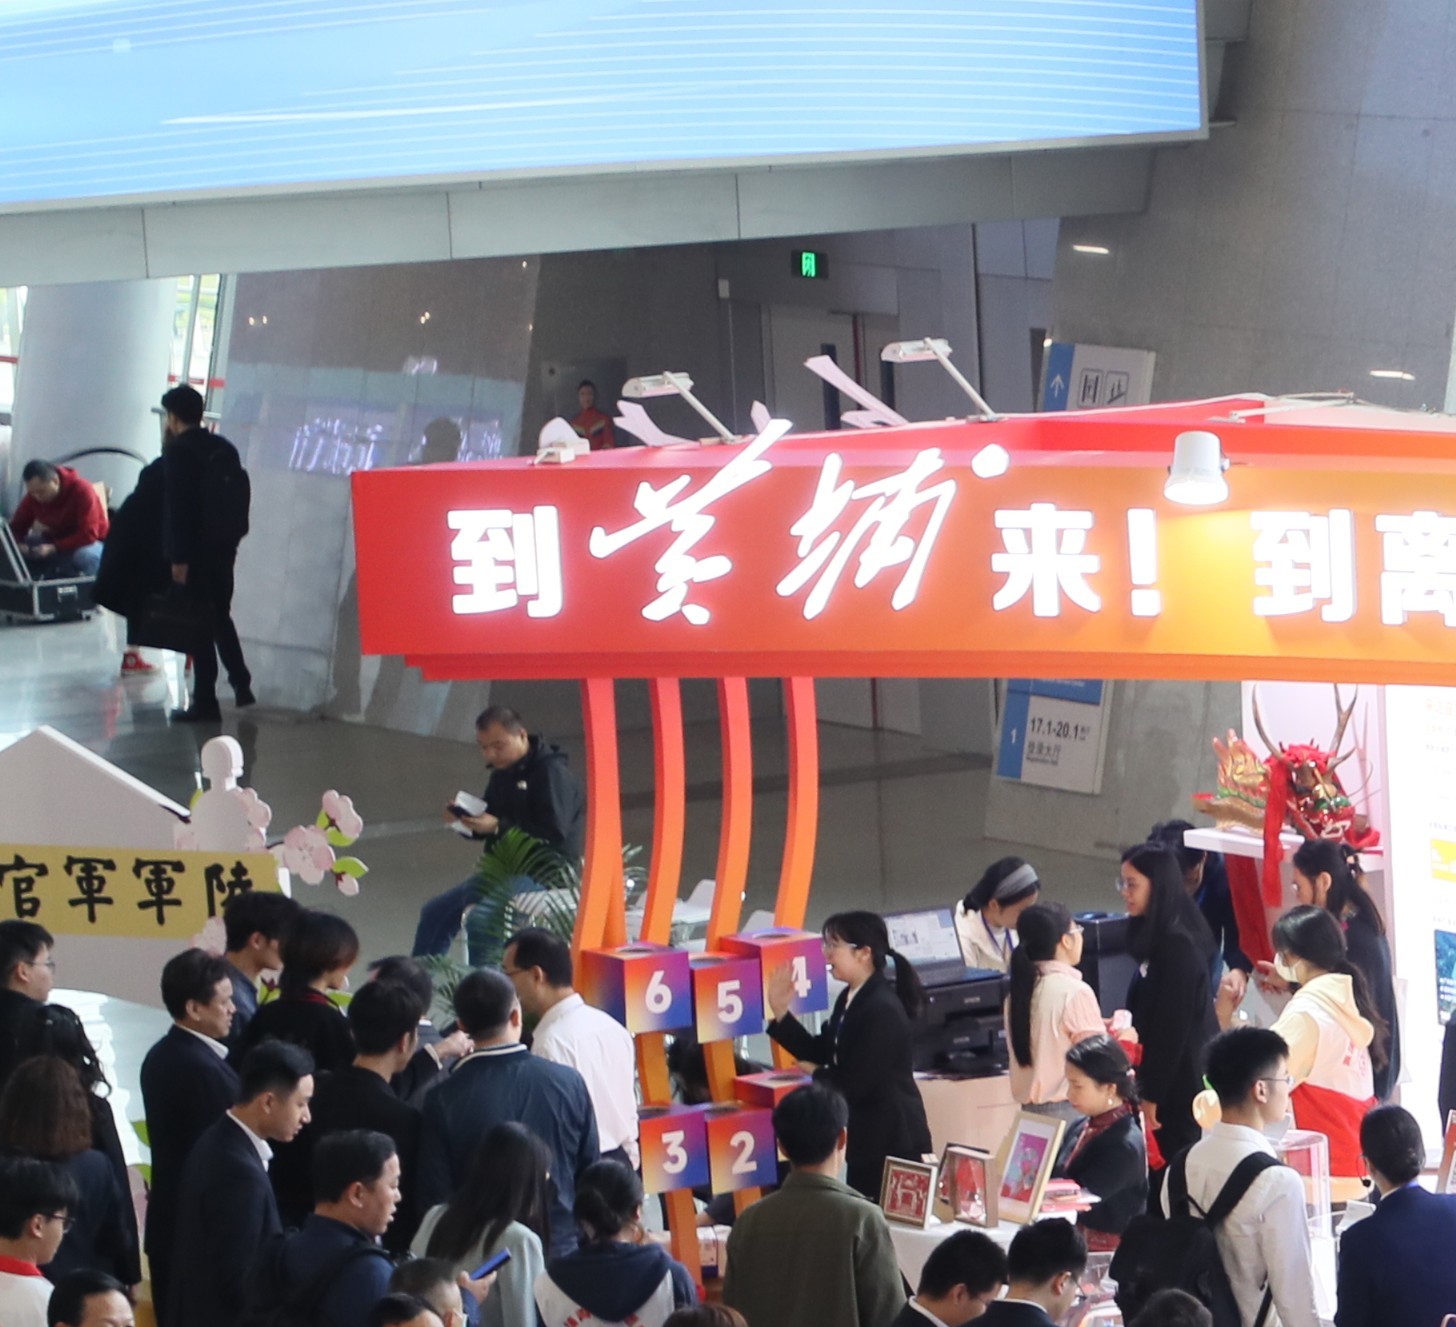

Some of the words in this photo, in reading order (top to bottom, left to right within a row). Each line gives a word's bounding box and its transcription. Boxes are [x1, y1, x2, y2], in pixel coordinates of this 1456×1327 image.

[645, 970, 673, 1014] 6
[717, 979, 743, 1023] 5
[661, 1130, 687, 1175] 3
[731, 1131, 758, 1175] 2
